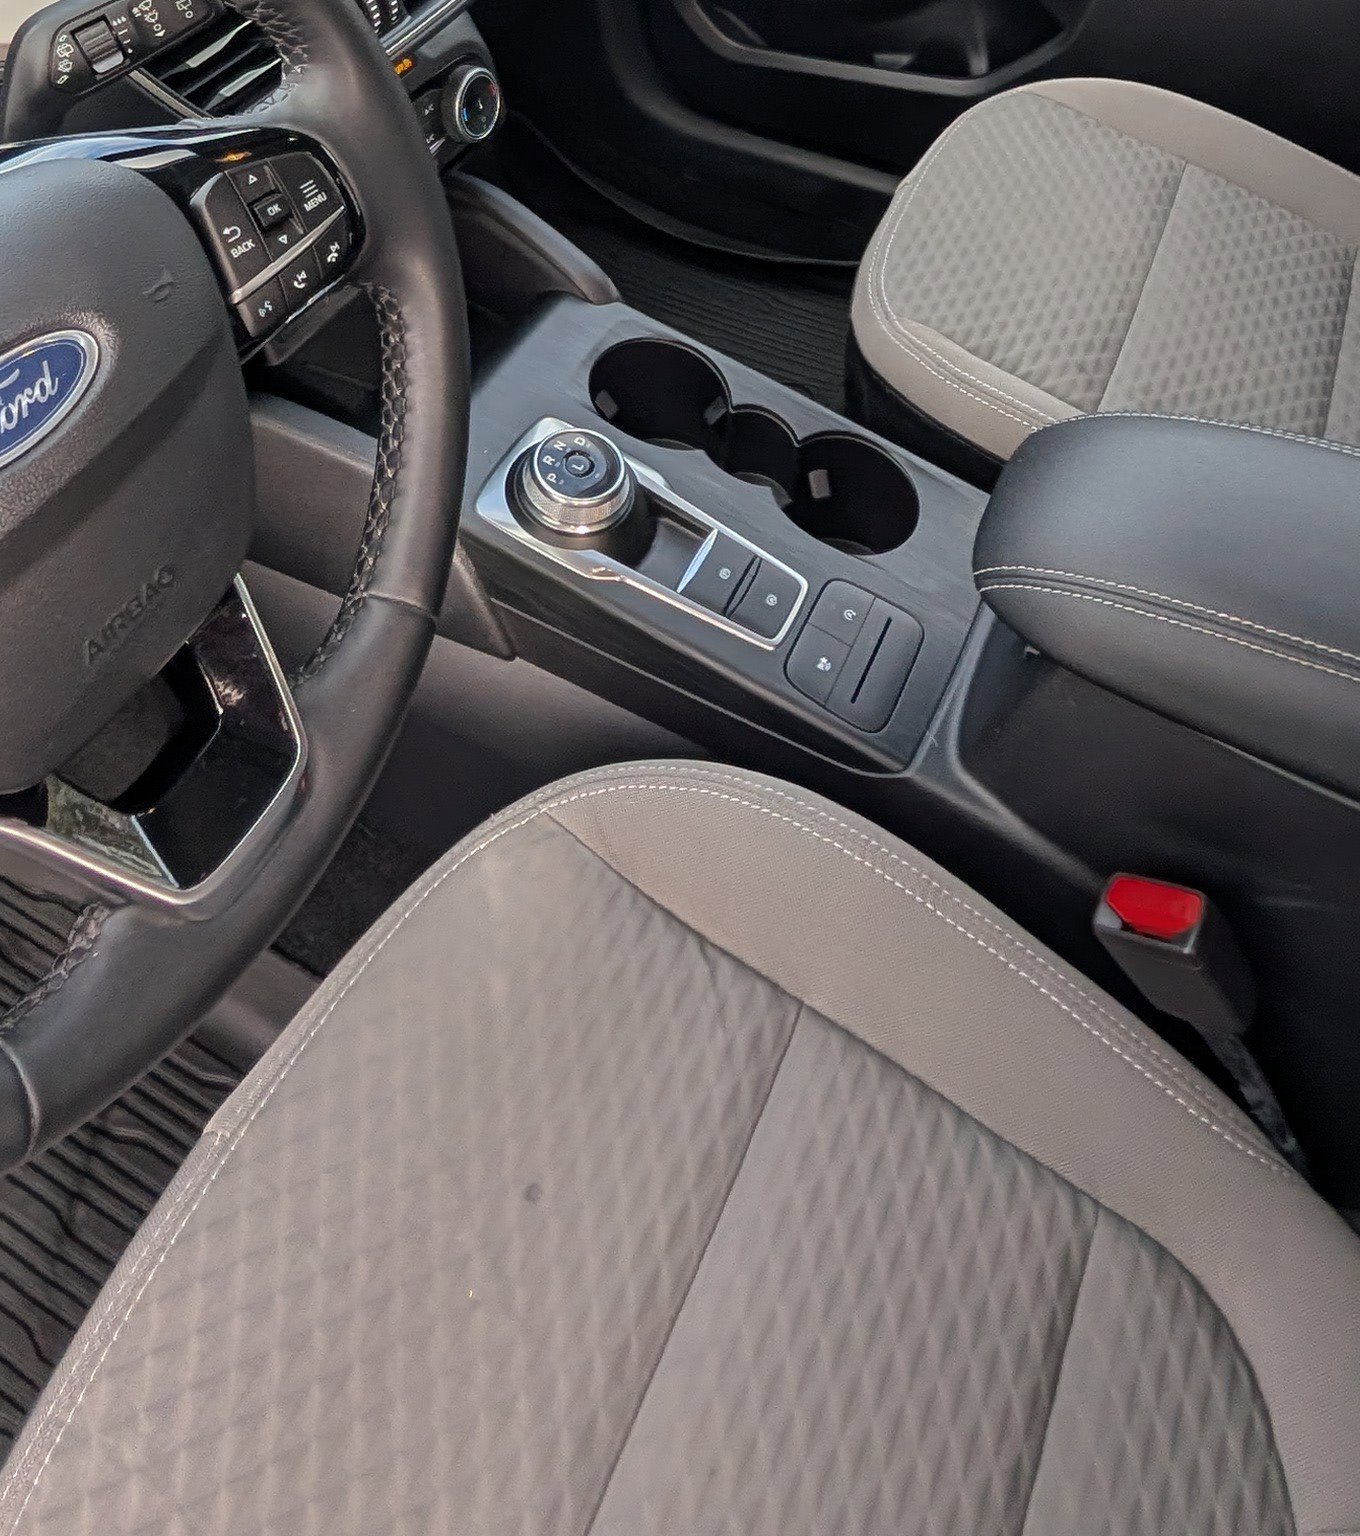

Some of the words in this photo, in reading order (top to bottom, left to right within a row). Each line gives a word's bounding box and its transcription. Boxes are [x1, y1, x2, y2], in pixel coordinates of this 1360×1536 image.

[266, 203, 282, 217] OK
[303, 191, 328, 212] MENU
[230, 238, 256, 259] BACK
[84, 564, 177, 665] AIRBAG
